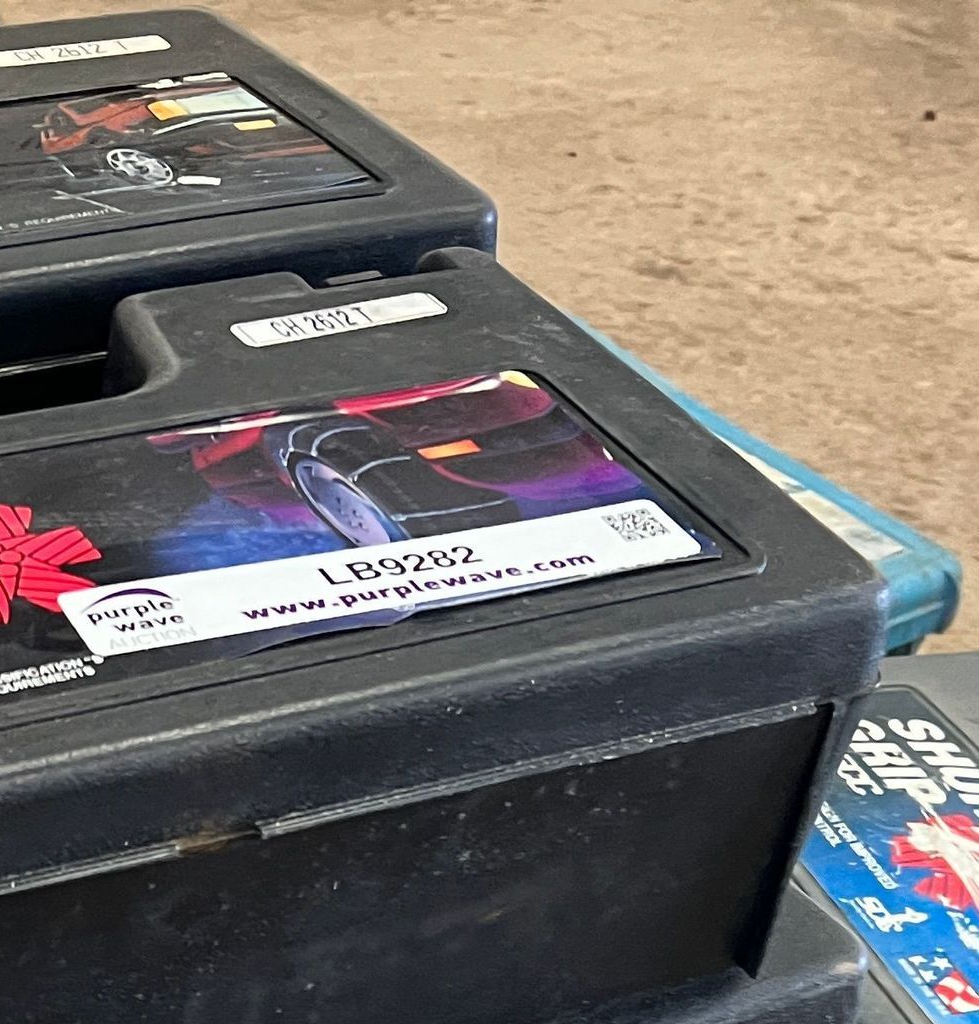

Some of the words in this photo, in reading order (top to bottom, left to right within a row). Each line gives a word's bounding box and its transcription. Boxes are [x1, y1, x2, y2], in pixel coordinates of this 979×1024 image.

[13, 50, 44, 63] CH
[51, 43, 108, 59] 2612
[270, 317, 306, 338] CH
[304, 309, 357, 332] 2612
[352, 306, 374, 323] T
[318, 545, 483, 586] LB9282
[240, 552, 596, 620] www.purplewave.com
[86, 599, 174, 626] purple
[113, 614, 185, 632] wave
[109, 625, 198, 650] AUCTION
[833, 821, 858, 844] FOR
[849, 841, 901, 890] IMPROVED
